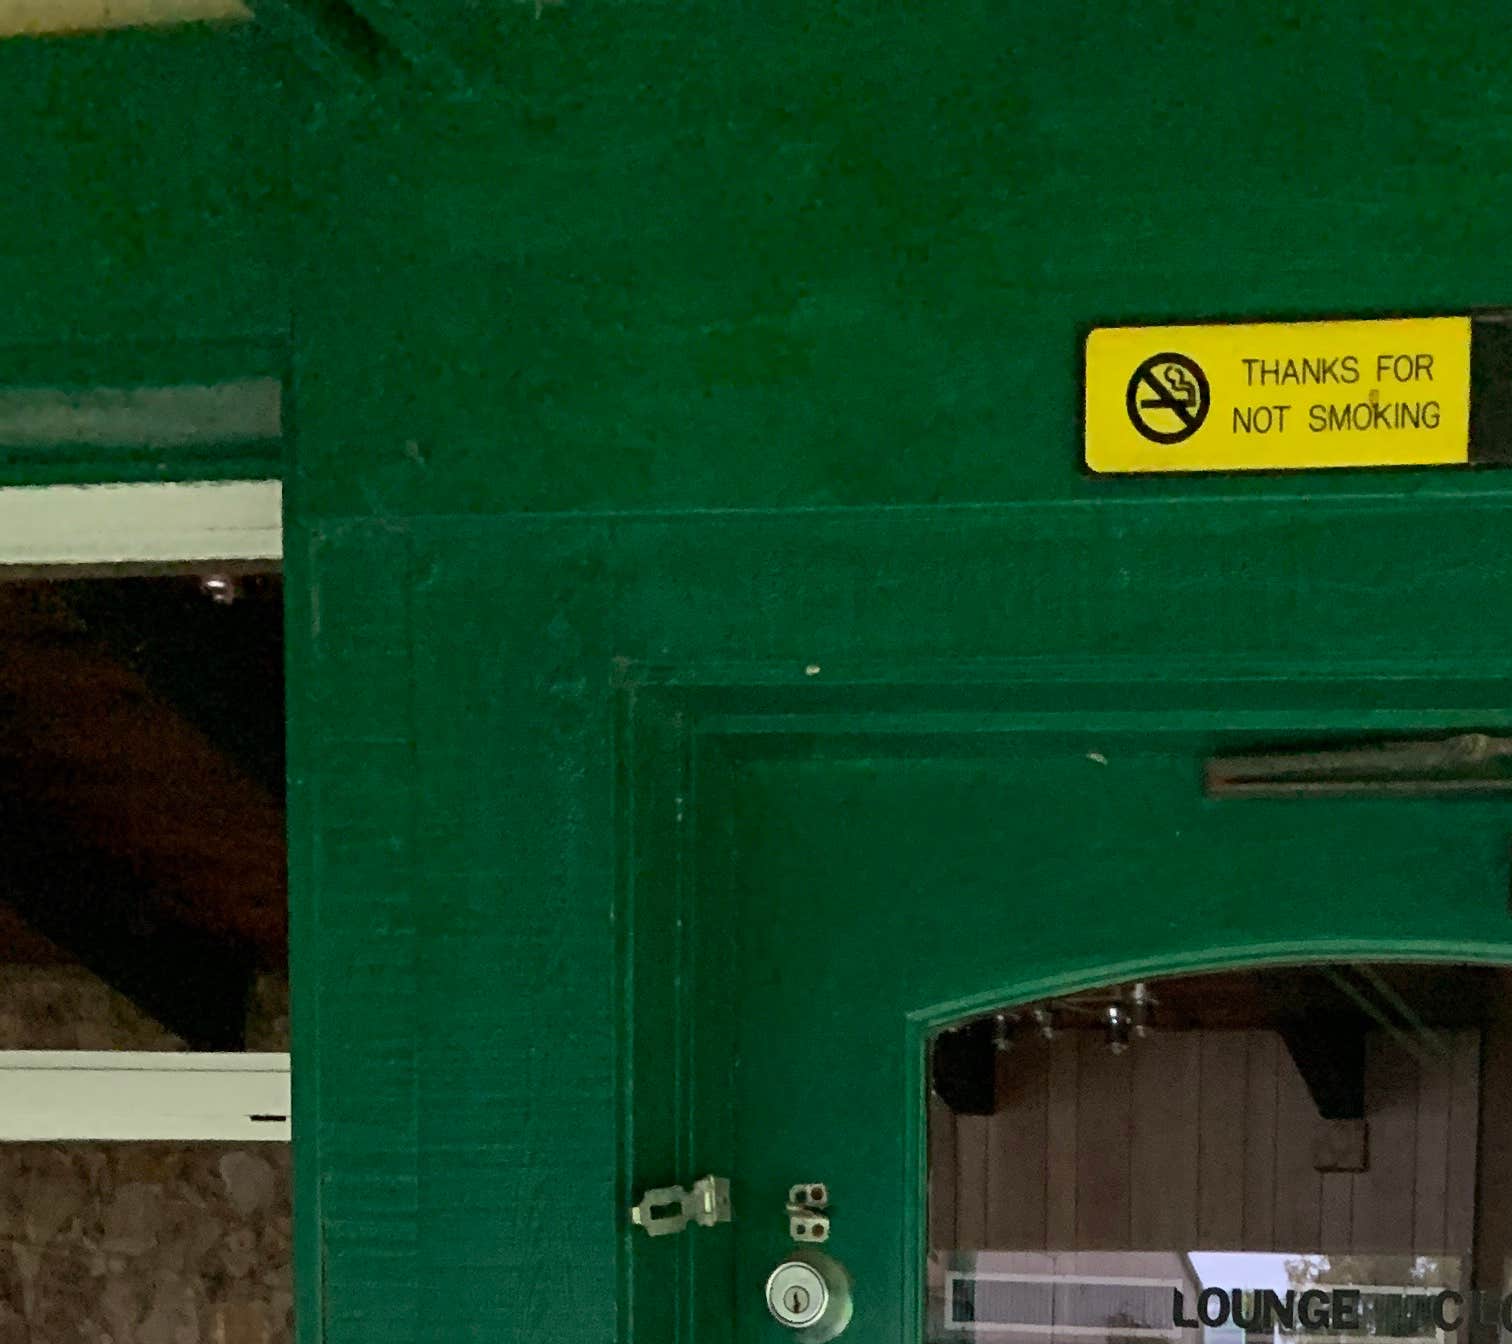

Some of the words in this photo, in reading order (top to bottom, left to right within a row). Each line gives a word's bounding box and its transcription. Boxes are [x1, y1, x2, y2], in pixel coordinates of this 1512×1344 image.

[1241, 355, 1361, 386] THANKS
[1376, 353, 1434, 383] FOR
[1232, 405, 1292, 434] NOT
[1307, 400, 1441, 433] SMOKING
[1172, 1286, 1361, 1331] LOUNGE
